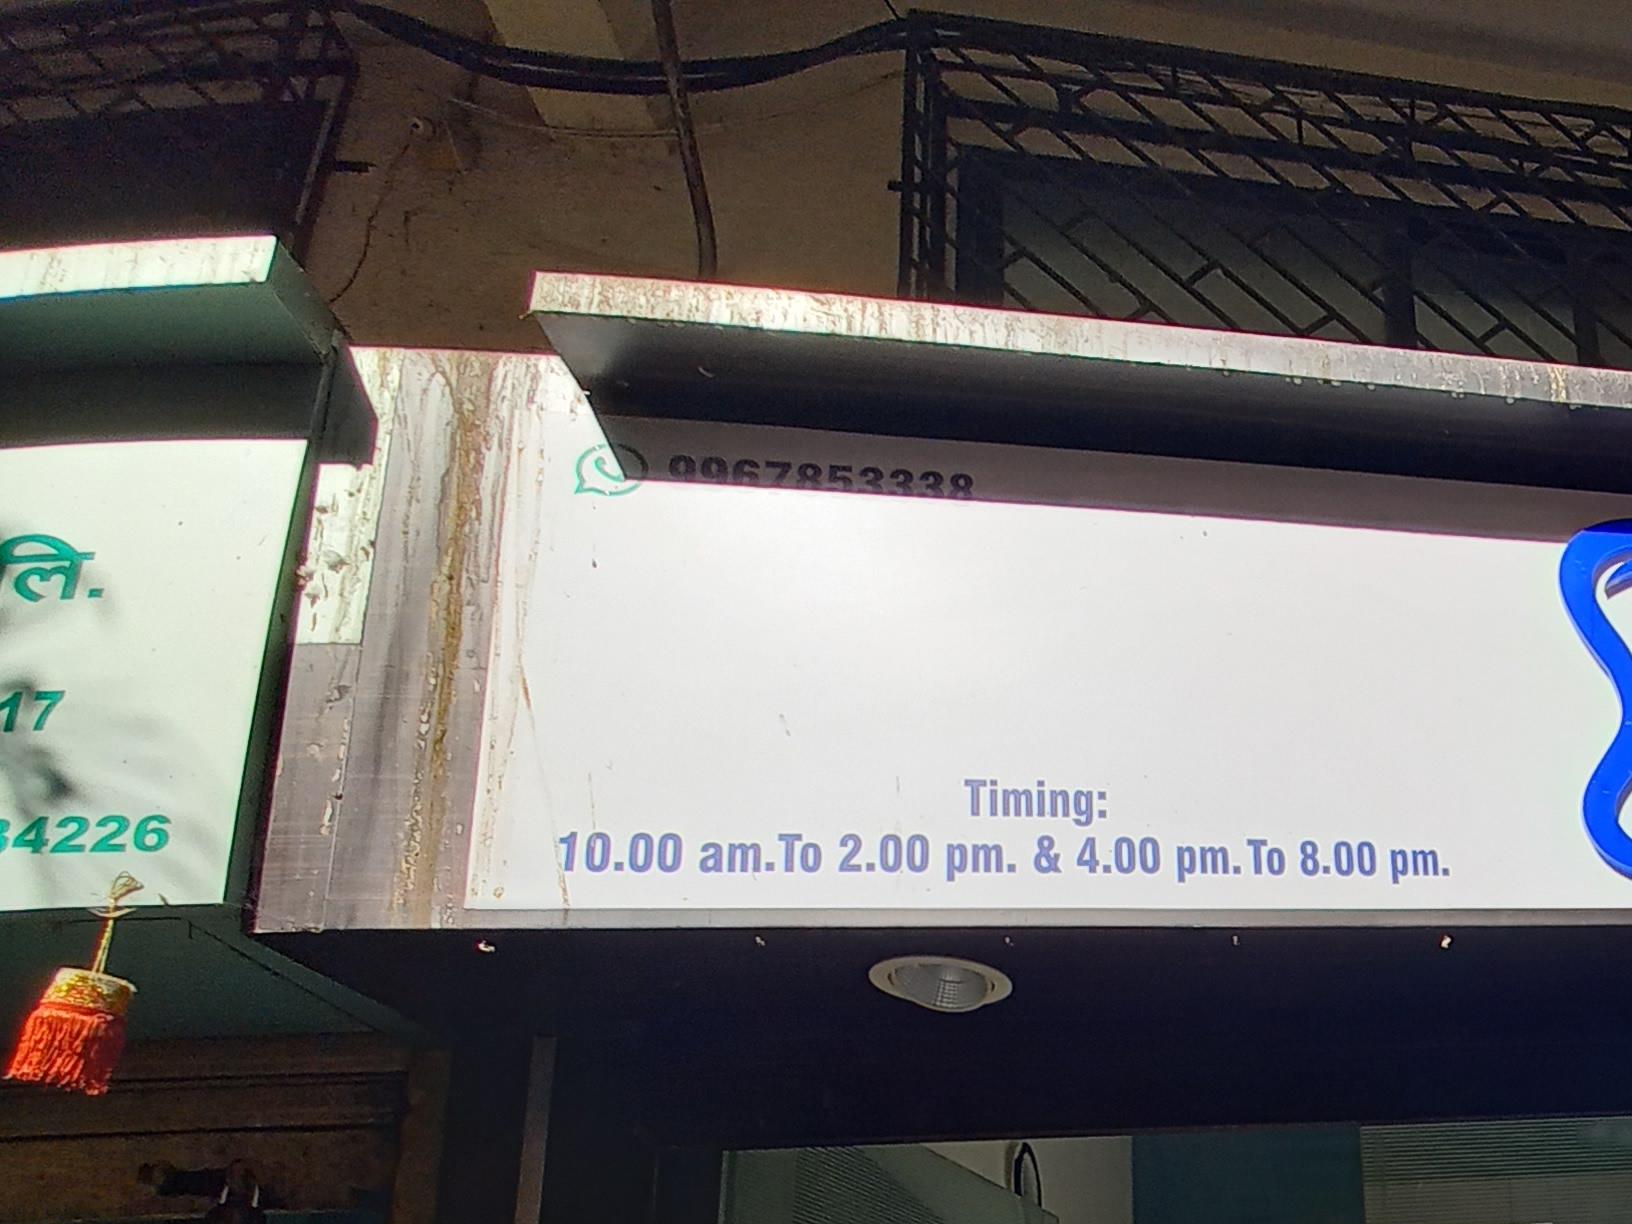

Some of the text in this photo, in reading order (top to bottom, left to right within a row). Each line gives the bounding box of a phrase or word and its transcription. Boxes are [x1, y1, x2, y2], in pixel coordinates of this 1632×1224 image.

[964, 779, 1108, 826] Timing:
[559, 832, 683, 873] 10.00
[838, 834, 930, 873] 2.00
[946, 841, 1017, 881] pm.
[1033, 836, 1062, 874] &
[1076, 837, 1161, 874] 4.00
[1300, 841, 1376, 877] 8.00
[1390, 848, 1451, 884] pm.
